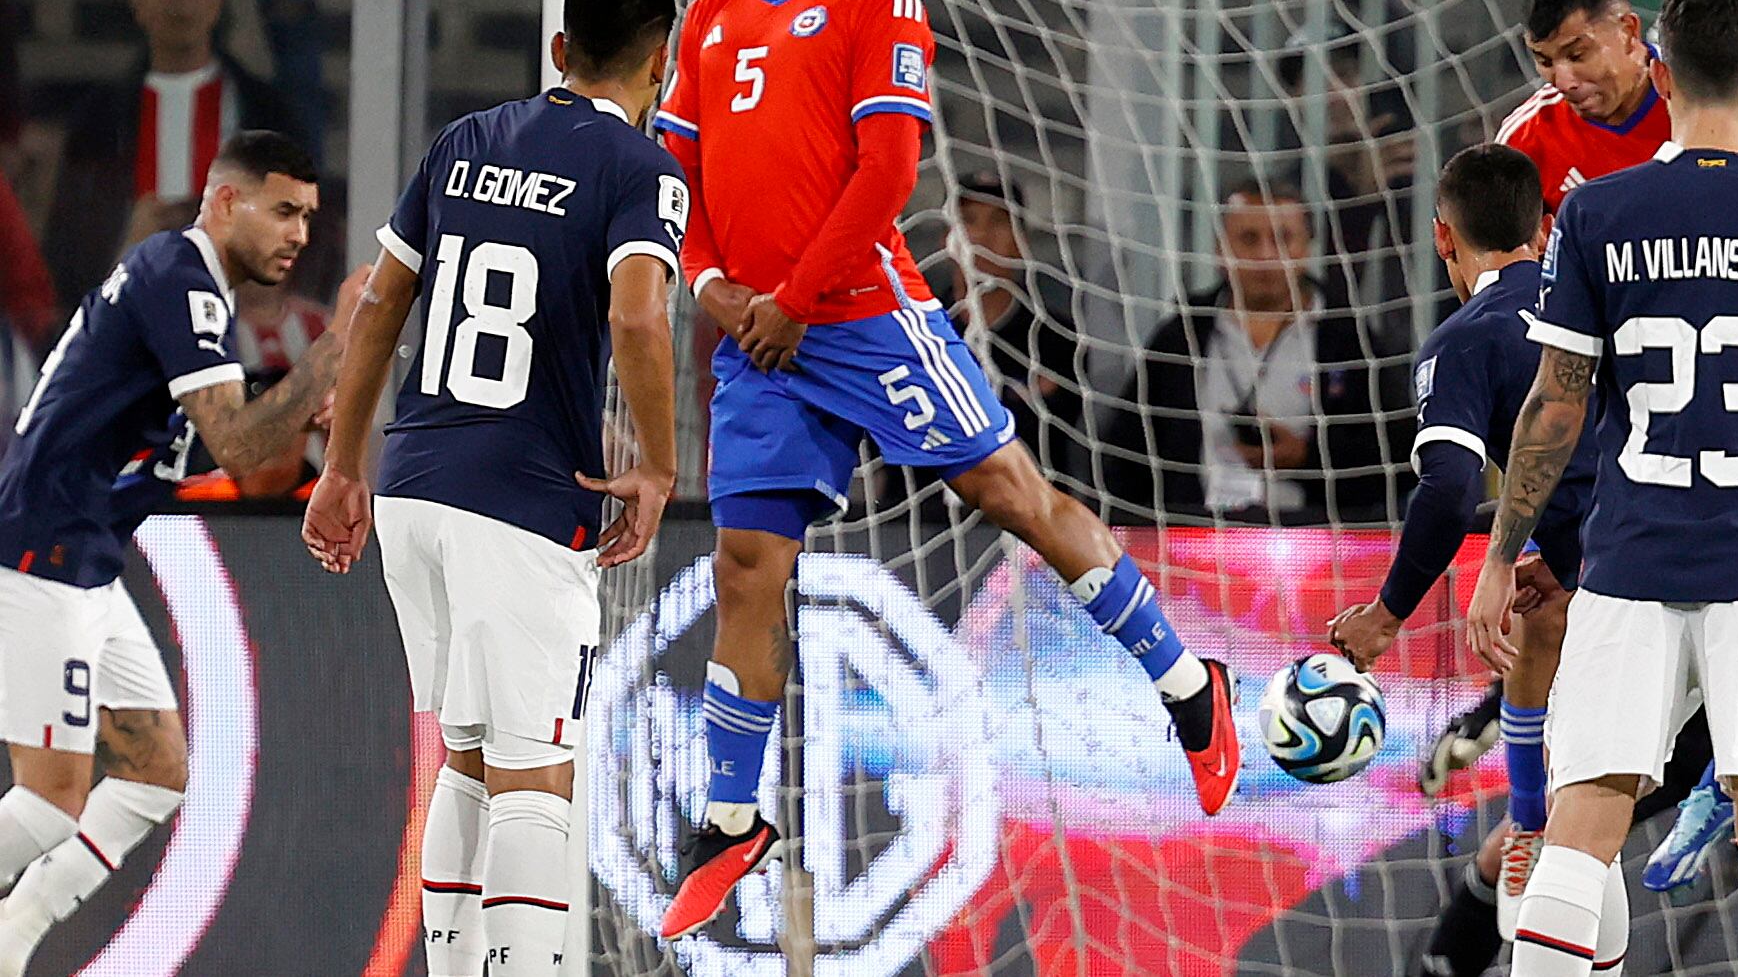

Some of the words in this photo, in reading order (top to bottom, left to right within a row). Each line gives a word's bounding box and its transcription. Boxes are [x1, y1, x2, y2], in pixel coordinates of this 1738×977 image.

[729, 45, 769, 113] 5
[472, 164, 577, 216] GOMEZ
[1605, 241, 1640, 283] M.
[420, 233, 540, 410] 18
[877, 364, 936, 431] 5
[62, 657, 91, 727] 9
